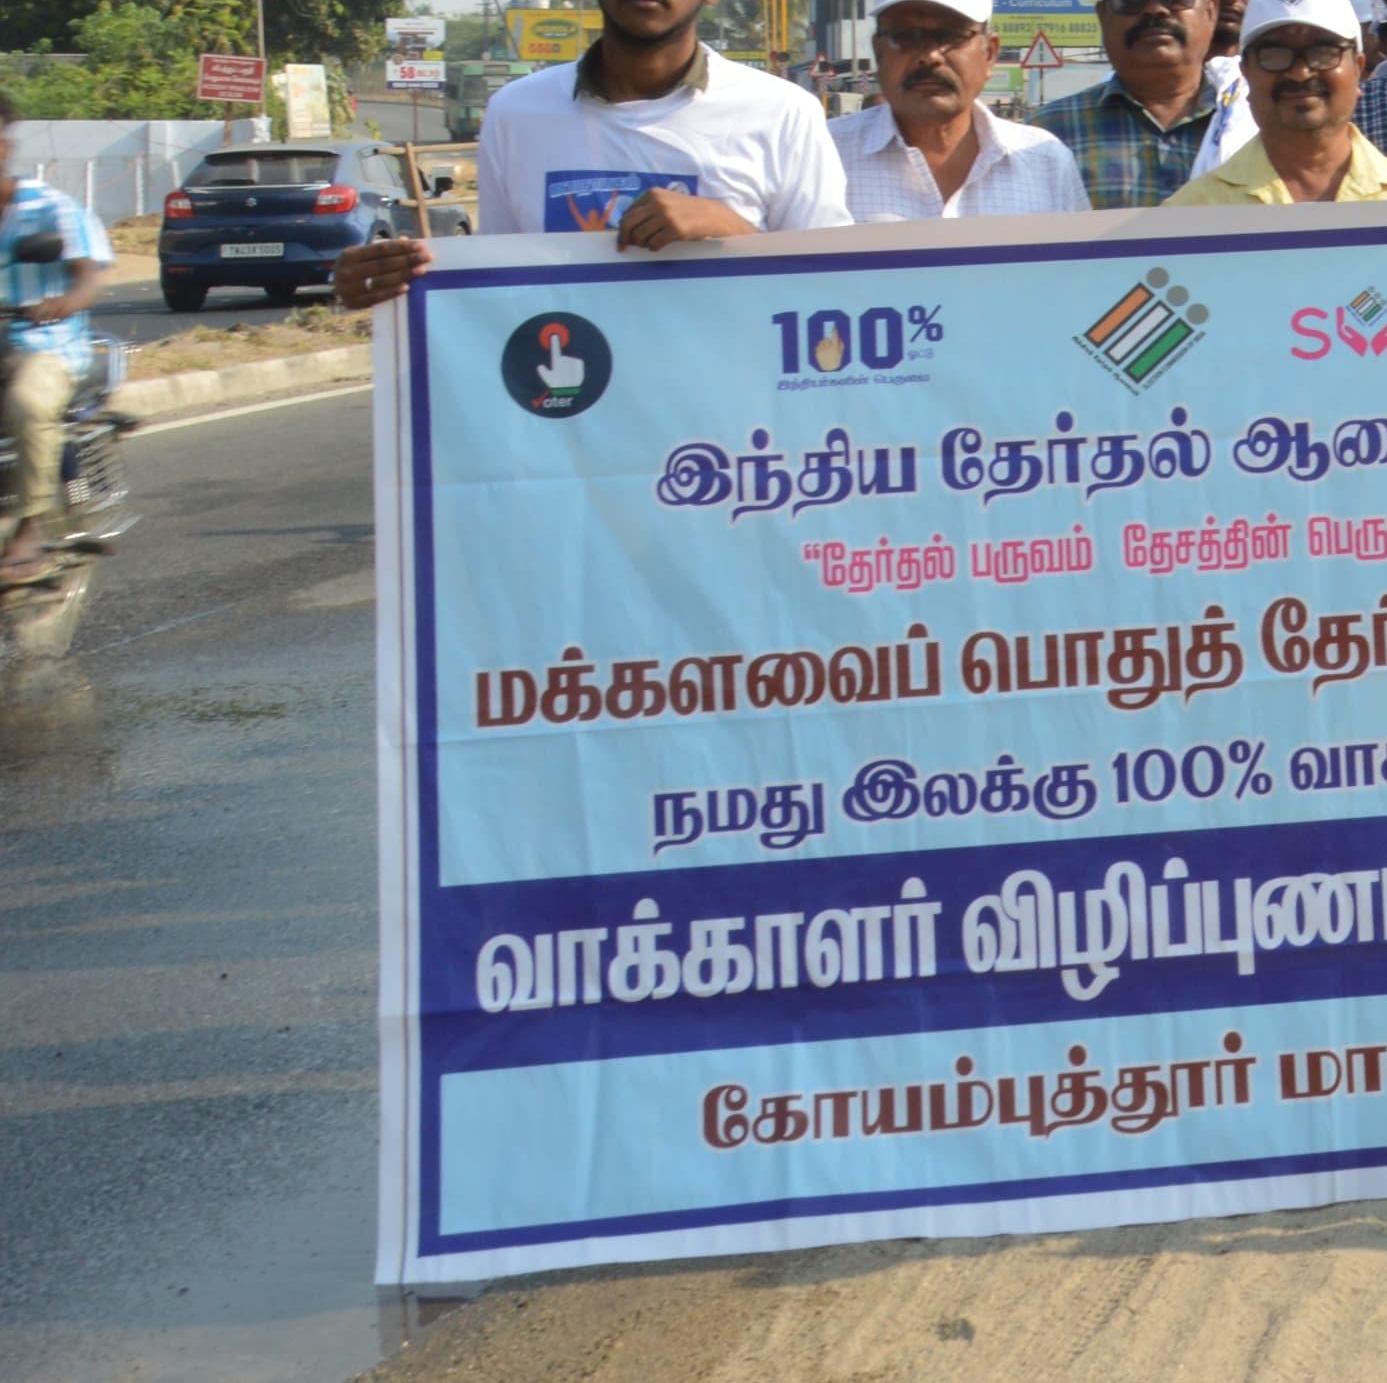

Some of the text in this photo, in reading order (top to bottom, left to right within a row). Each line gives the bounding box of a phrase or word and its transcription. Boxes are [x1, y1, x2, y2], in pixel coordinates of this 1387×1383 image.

[771, 303, 944, 375] 100%
[655, 427, 918, 521] இந்திய
[941, 408, 1212, 506] தேர்தல்
[970, 523, 1093, 585] பருவம்
[1122, 512, 1293, 575] தேசத்தின்
[475, 622, 941, 728] மக்களவைப்
[961, 604, 1243, 711] பொதுத்
[652, 782, 826, 857] நமது
[842, 753, 1098, 820] இலக்கு
[1112, 739, 1274, 804] 100%
[476, 877, 943, 1013] வாக்காளர்
[702, 1030, 1256, 1148] கோயம்புத்தூர்
